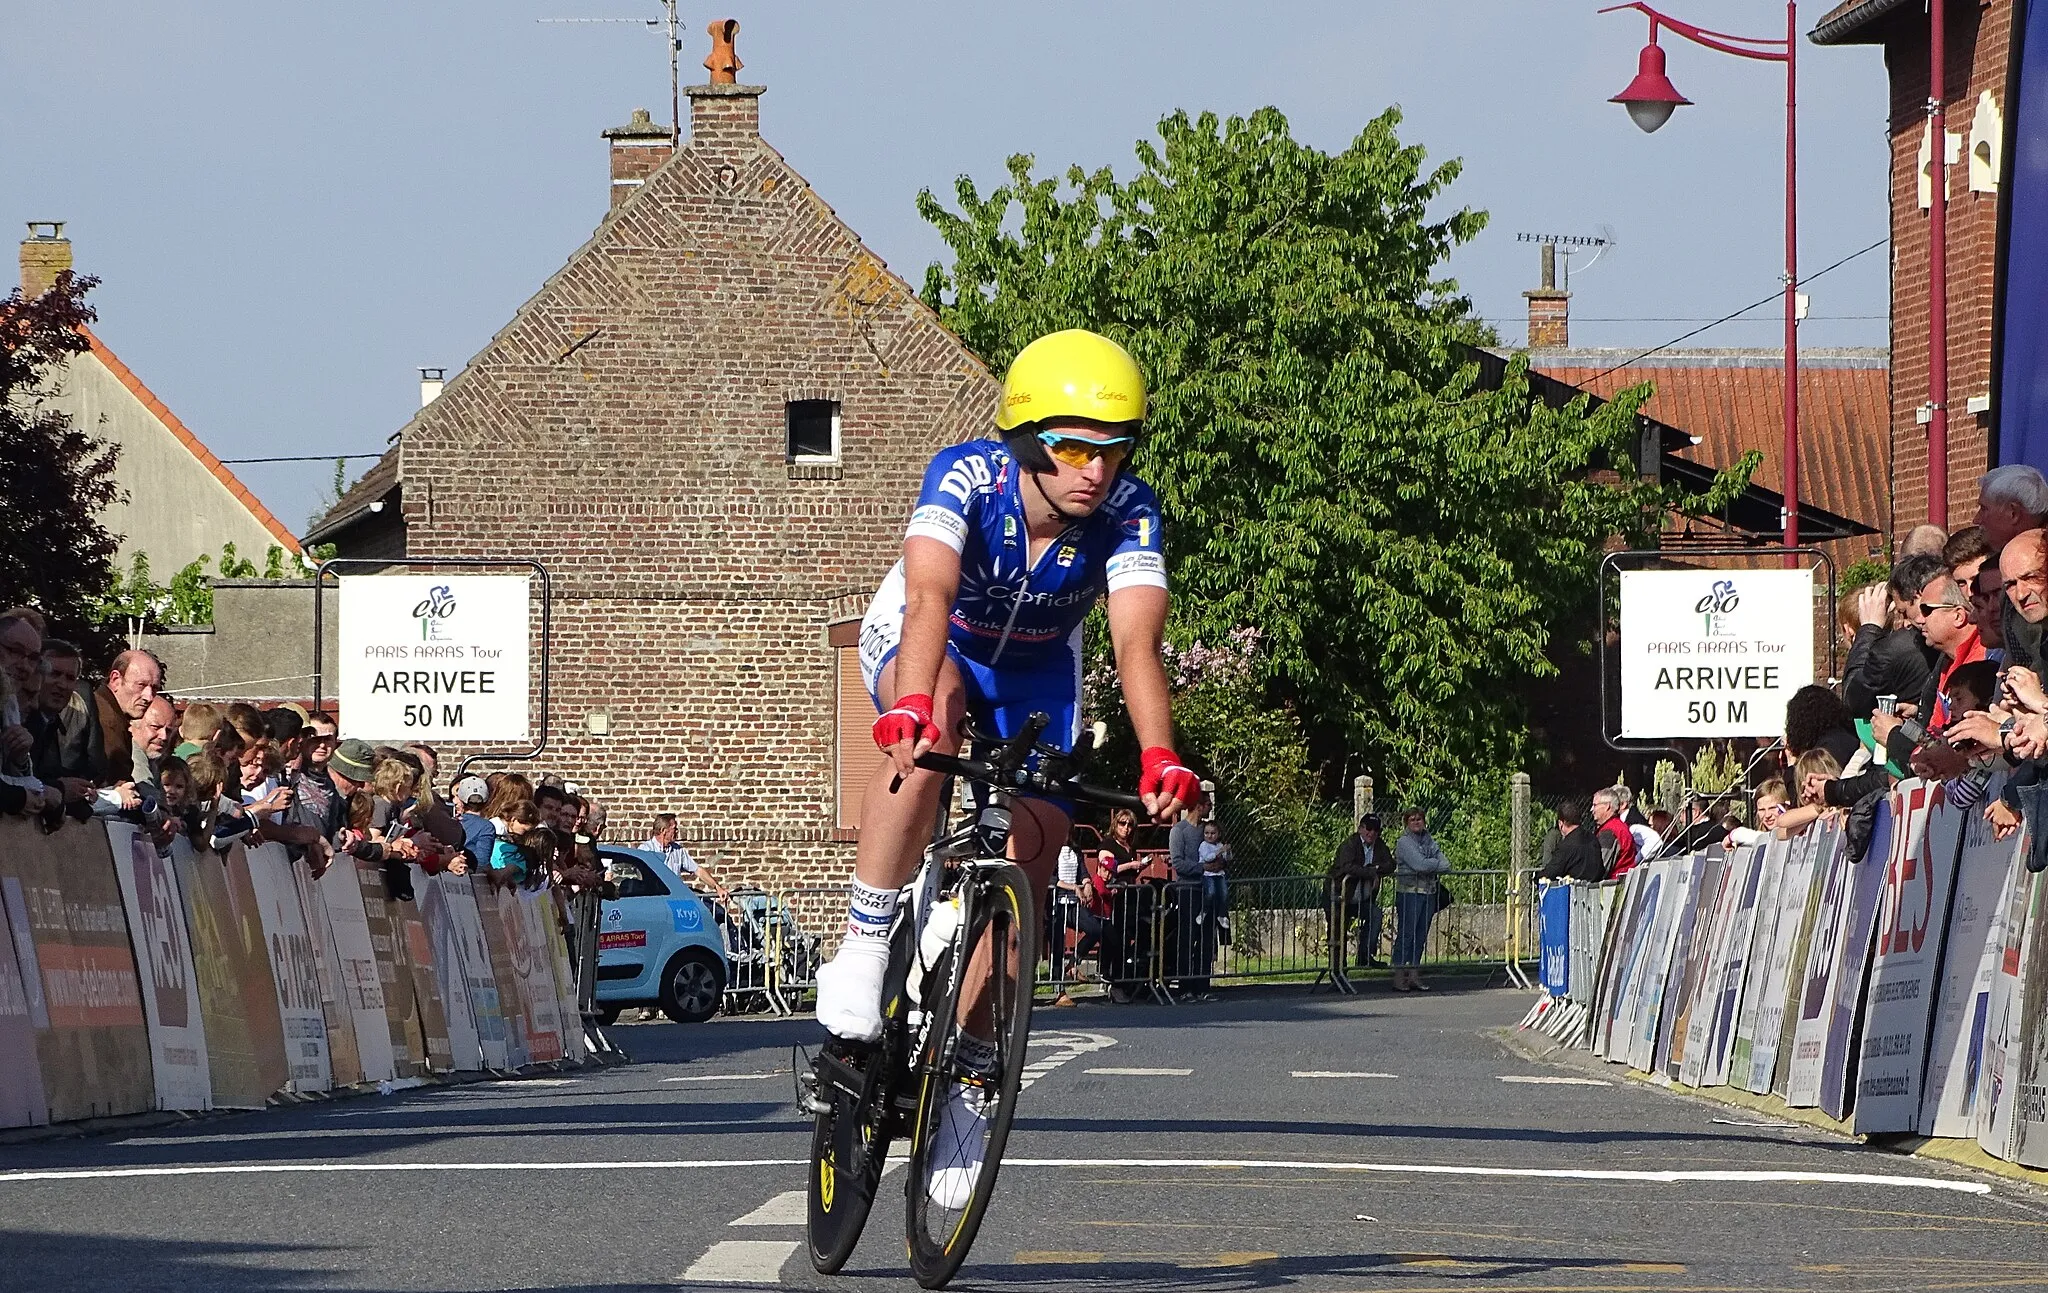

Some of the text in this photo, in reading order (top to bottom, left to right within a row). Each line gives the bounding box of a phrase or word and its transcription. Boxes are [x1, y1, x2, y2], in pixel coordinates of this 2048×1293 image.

[1096, 391, 1128, 402] Cofidis
[938, 454, 992, 505] DIB
[1133, 560, 1159, 569] Flandre
[1137, 553, 1158, 562] Dunes
[986, 584, 1095, 608] Cofidis
[365, 645, 504, 658] PARIS ARRAS Tour
[1647, 640, 1787, 654] PARIS ARRAS Tour
[371, 671, 496, 694] ARRIVEE
[1654, 666, 1780, 690] ARRIVEE
[403, 704, 464, 727] 50 M
[1687, 700, 1748, 724] 50 M
[1880, 782, 1946, 956] BES
[676, 908, 698, 921] Krys
[606, 933, 630, 943] ARRAS
[946, 925, 964, 997] KUOTA
[908, 1010, 935, 1072] KALIBUR
